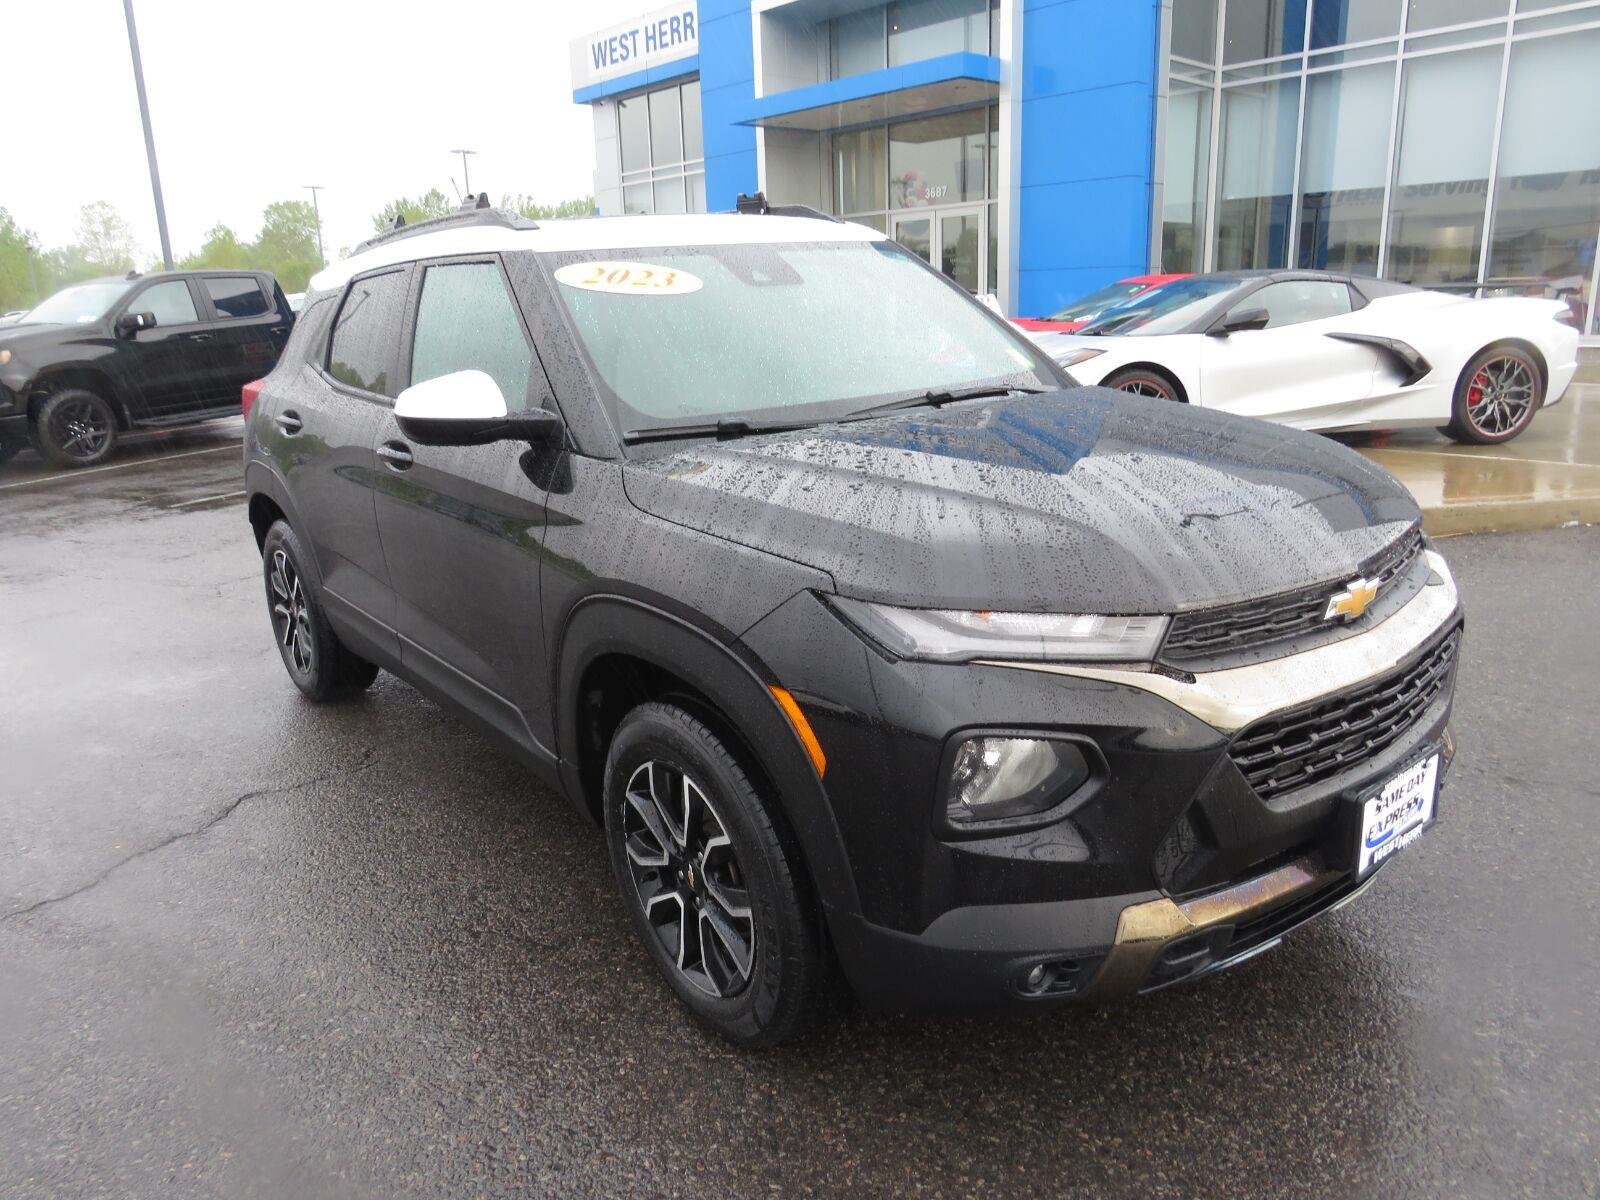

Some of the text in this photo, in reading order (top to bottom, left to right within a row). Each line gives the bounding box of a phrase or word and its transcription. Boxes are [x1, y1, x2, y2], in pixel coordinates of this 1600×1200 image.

[592, 11, 695, 70] WEST HERR
[925, 185, 948, 199] 3687
[582, 267, 677, 288] 2023
[1375, 783, 1406, 816] SAME
[1406, 771, 1426, 793] DAY
